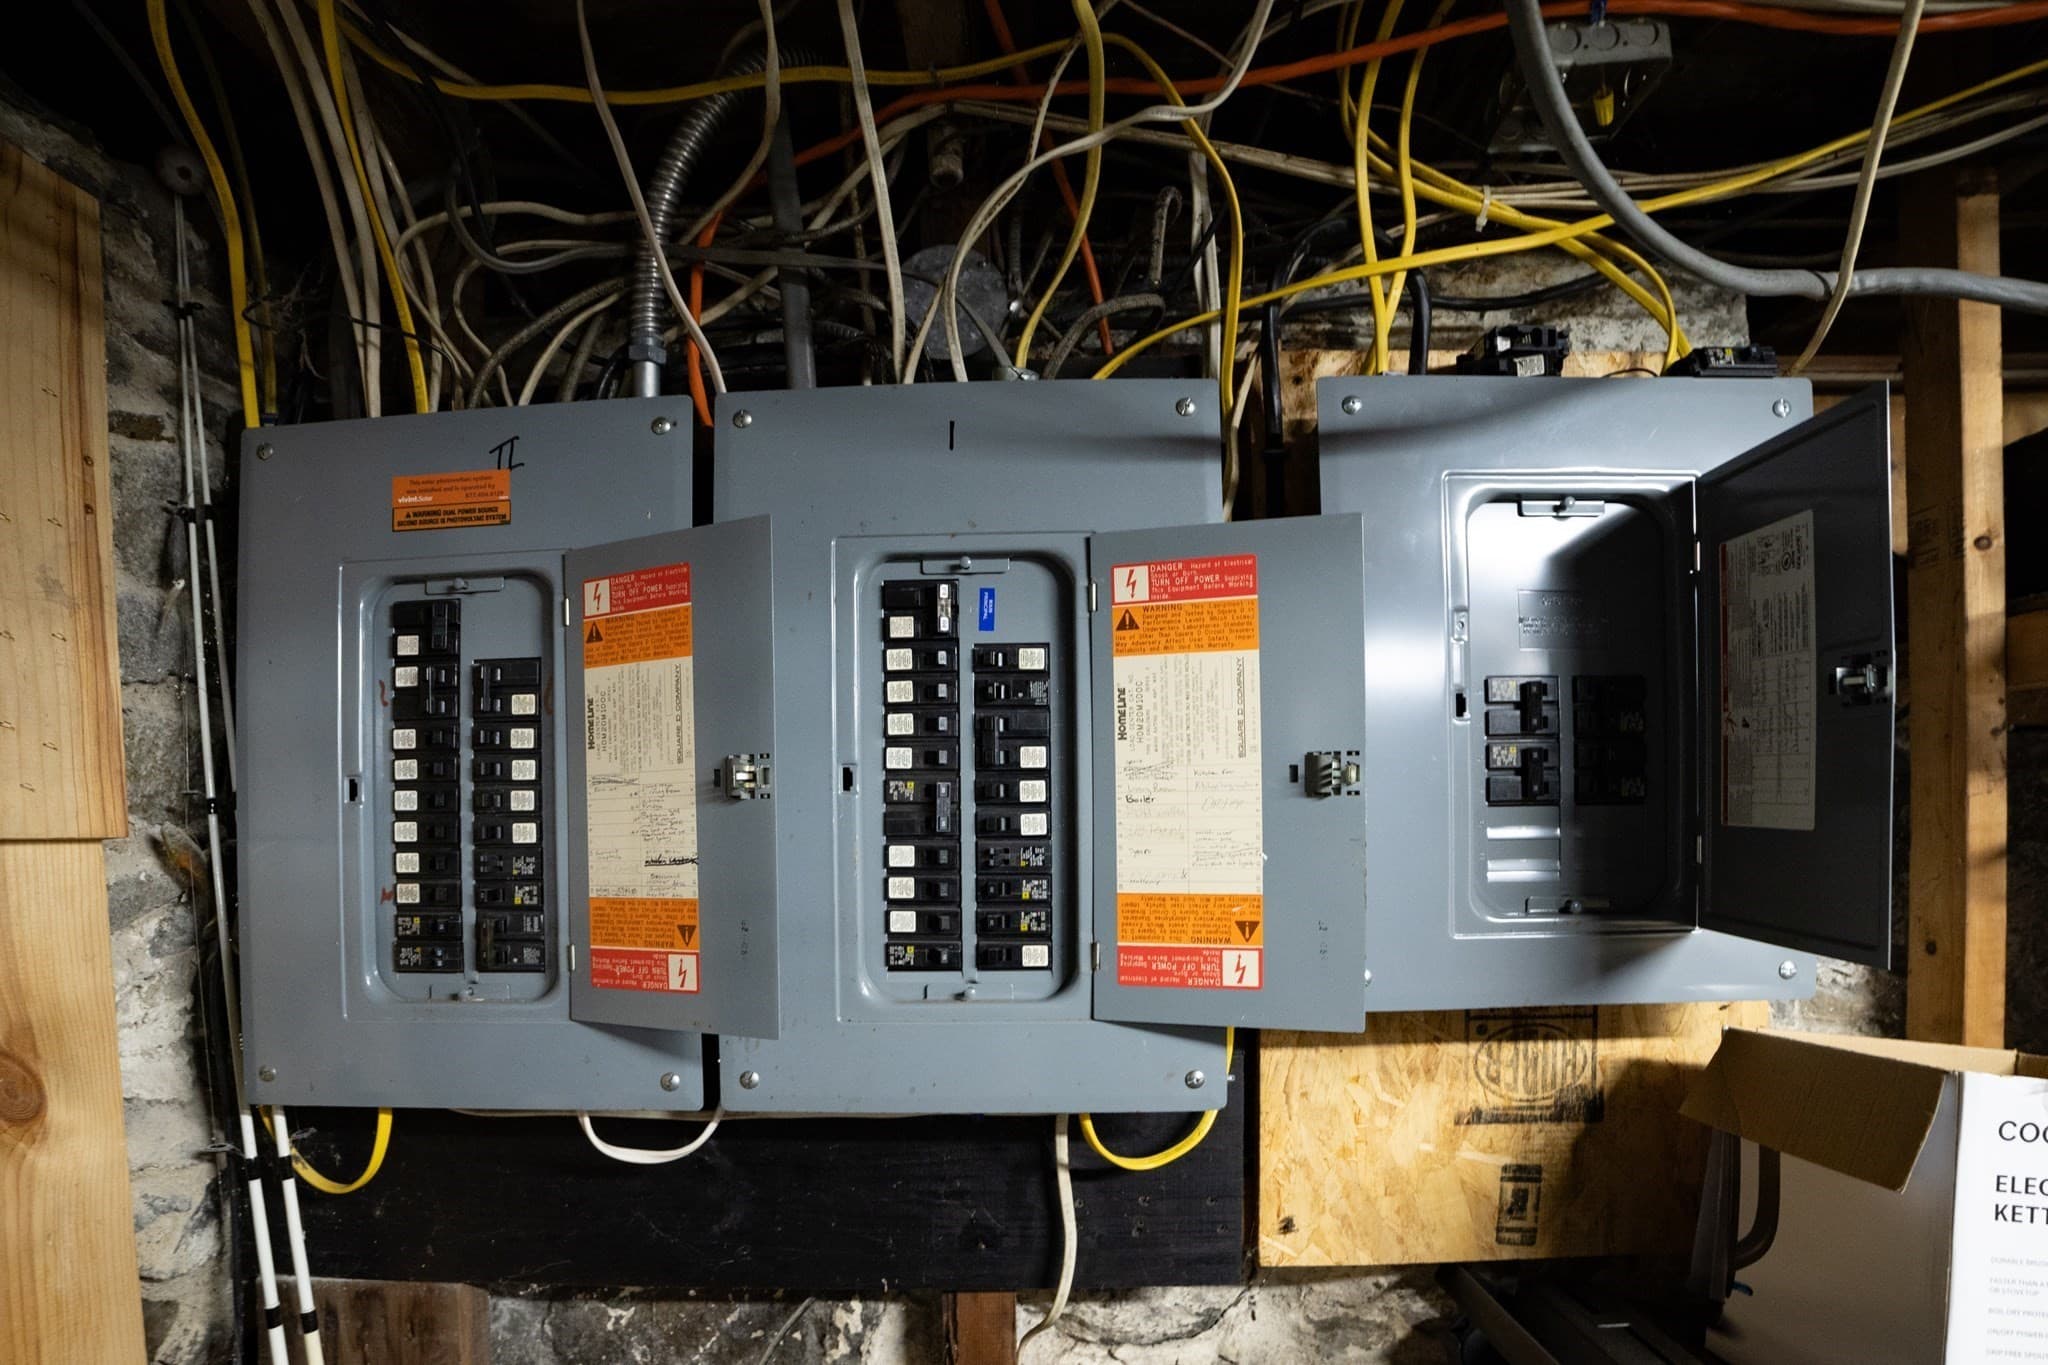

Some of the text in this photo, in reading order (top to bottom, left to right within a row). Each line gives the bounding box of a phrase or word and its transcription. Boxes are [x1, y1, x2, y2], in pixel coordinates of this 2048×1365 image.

[1151, 578, 1170, 587] TURN
[1175, 576, 1189, 585] OFF
[1194, 575, 1220, 583] POWER
[643, 583, 662, 593] POWER
[1143, 604, 1183, 612] WARNING
[1998, 1120, 2048, 1144] CO
